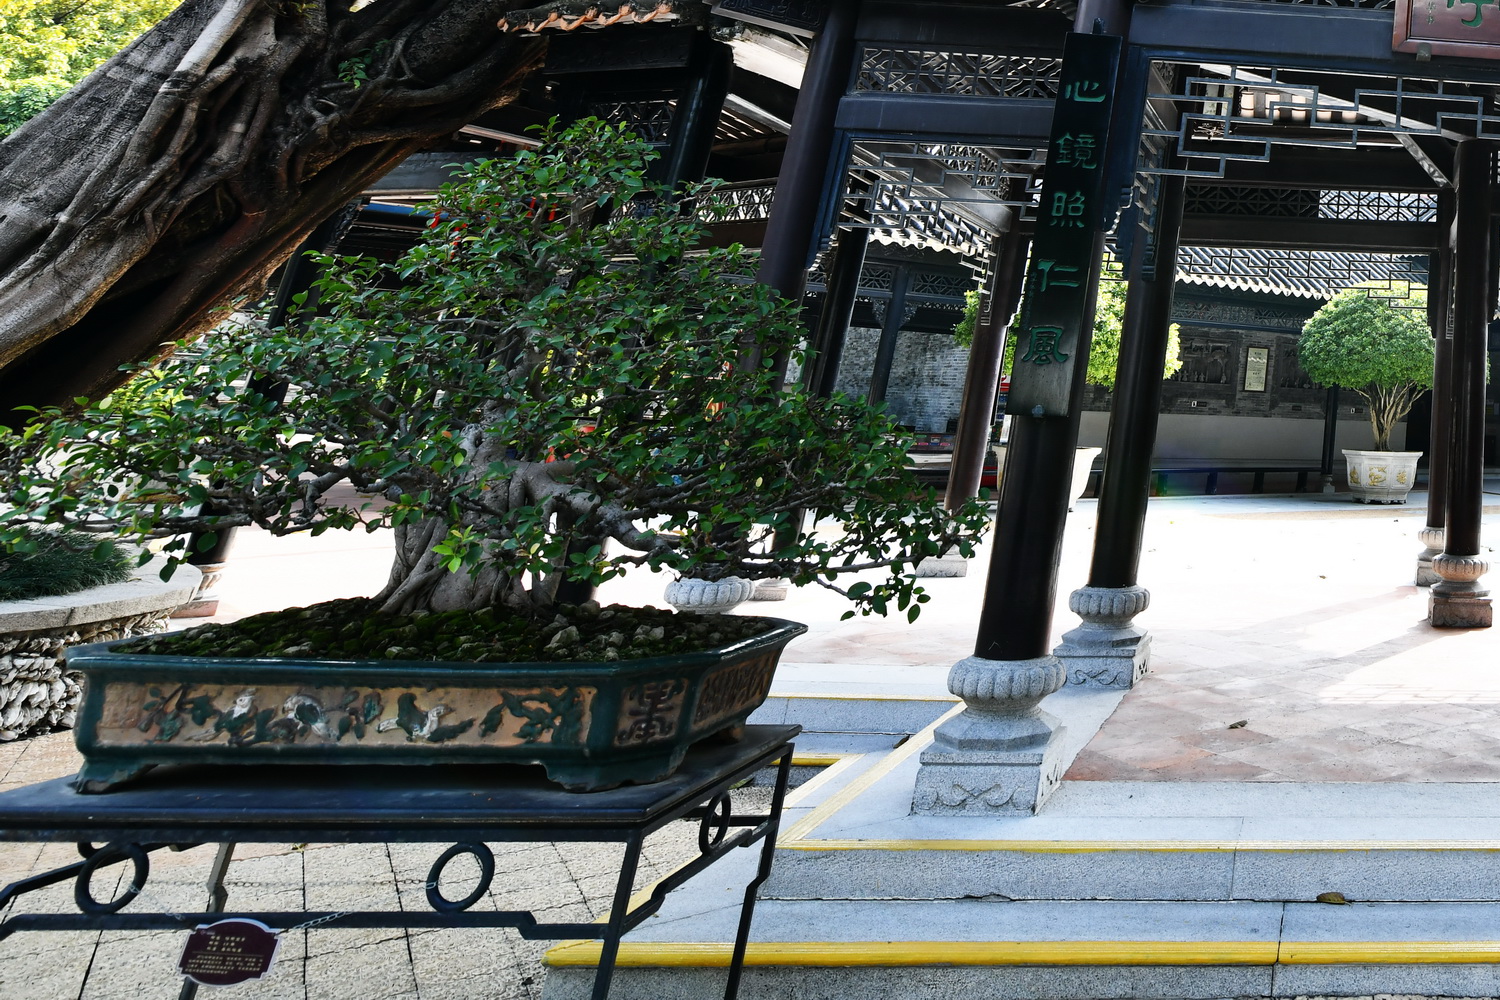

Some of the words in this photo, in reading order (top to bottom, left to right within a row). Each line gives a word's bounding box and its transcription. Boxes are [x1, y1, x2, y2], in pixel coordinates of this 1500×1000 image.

[1021, 80, 1106, 365] 心鏡照仁風
